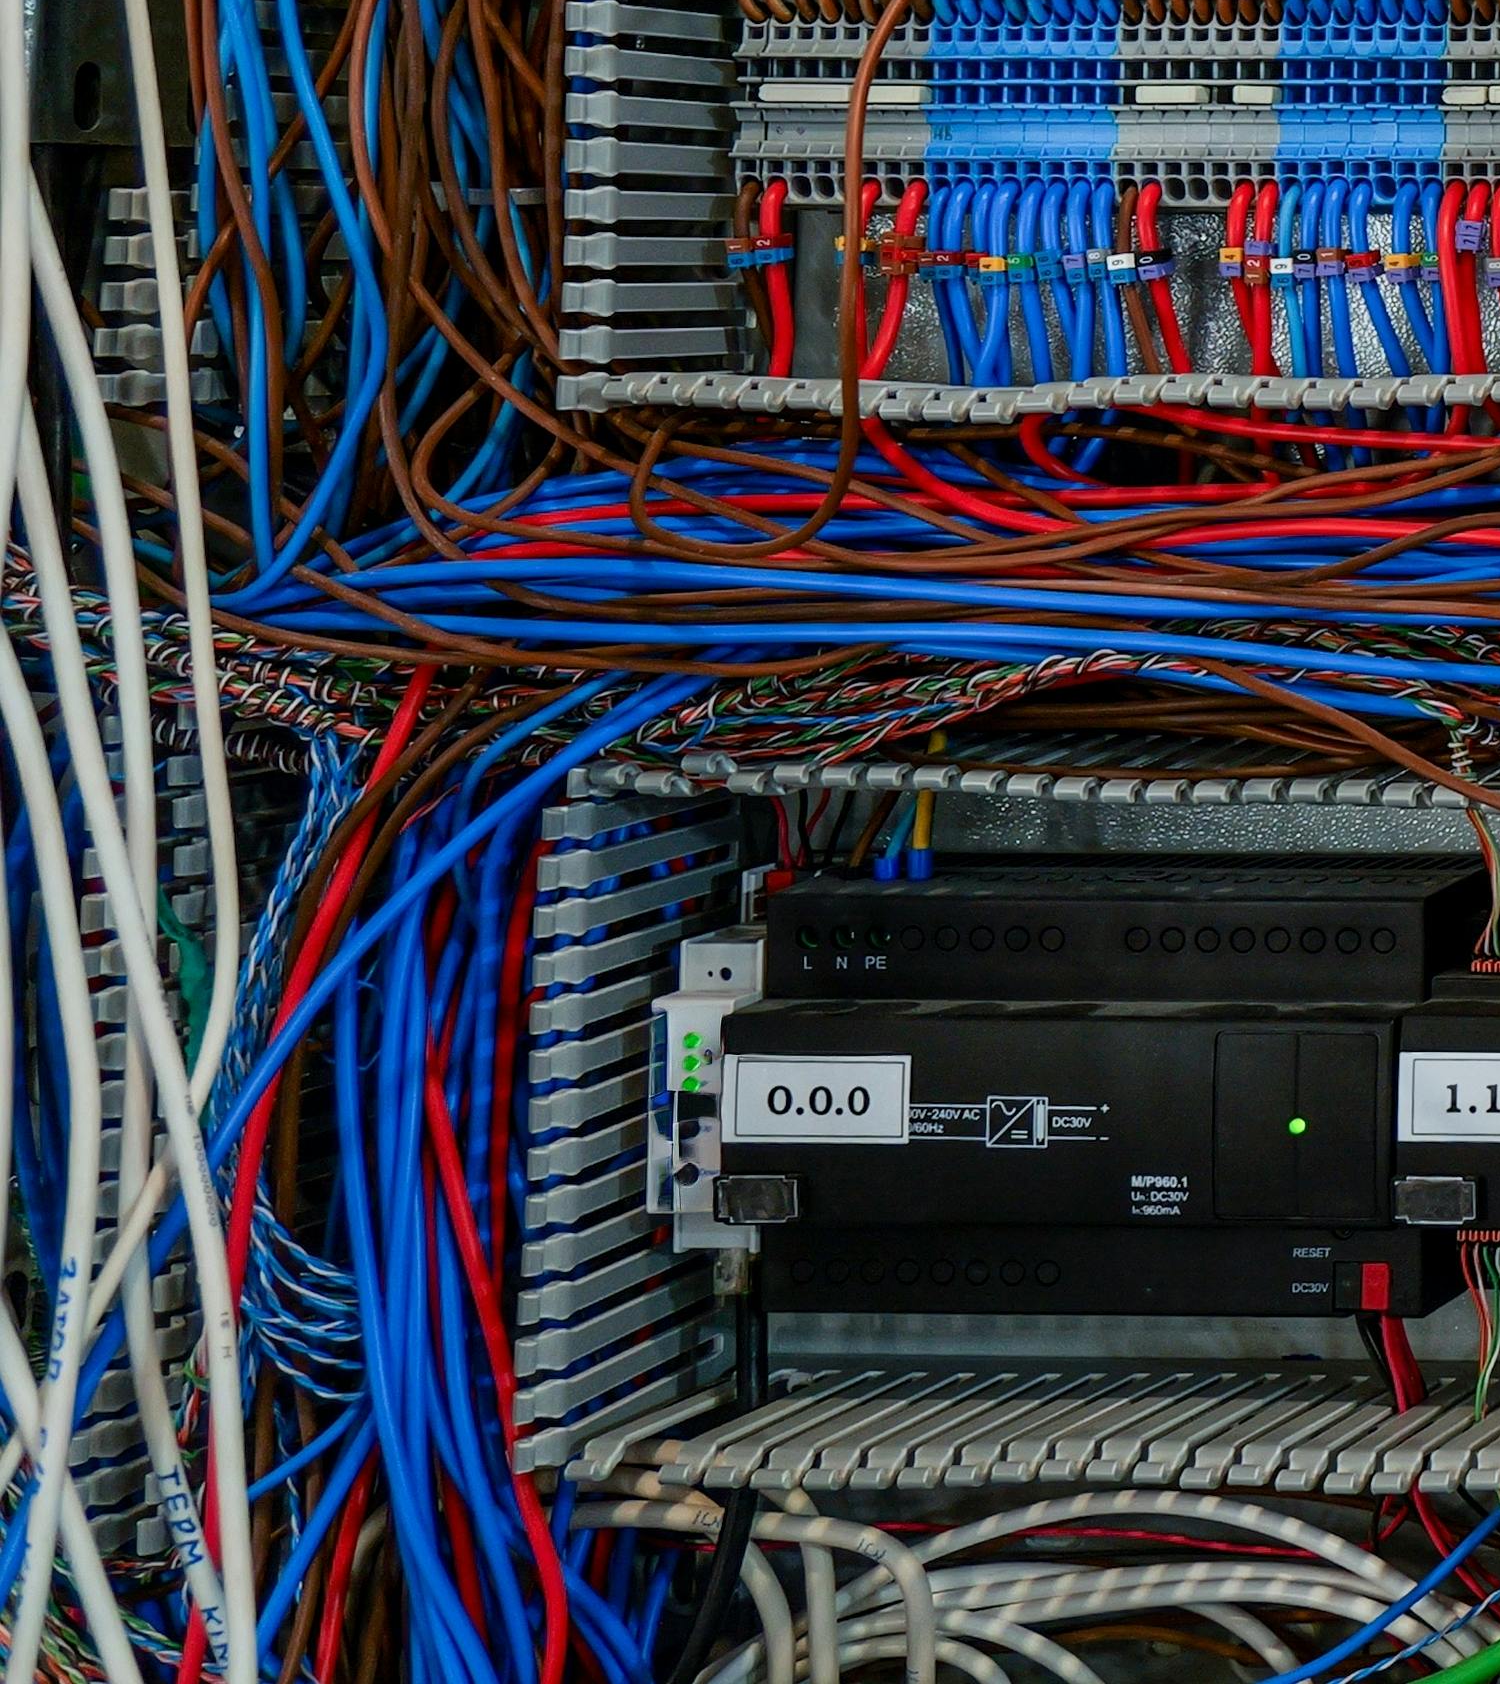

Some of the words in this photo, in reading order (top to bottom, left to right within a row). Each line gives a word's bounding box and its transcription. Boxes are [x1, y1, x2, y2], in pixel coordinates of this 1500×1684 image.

[804, 956, 812, 969] L
[836, 957, 847, 969] N
[865, 956, 886, 969] PE
[768, 1086, 870, 1116] 0.0.0
[963, 1109, 980, 1119] AC
[1052, 1117, 1092, 1128] DC30V
[1132, 1176, 1187, 1187] M/P960.1
[1151, 1191, 1188, 1201] DC30V
[1293, 1248, 1331, 1257] RESET
[1292, 1283, 1329, 1293] DC30V
